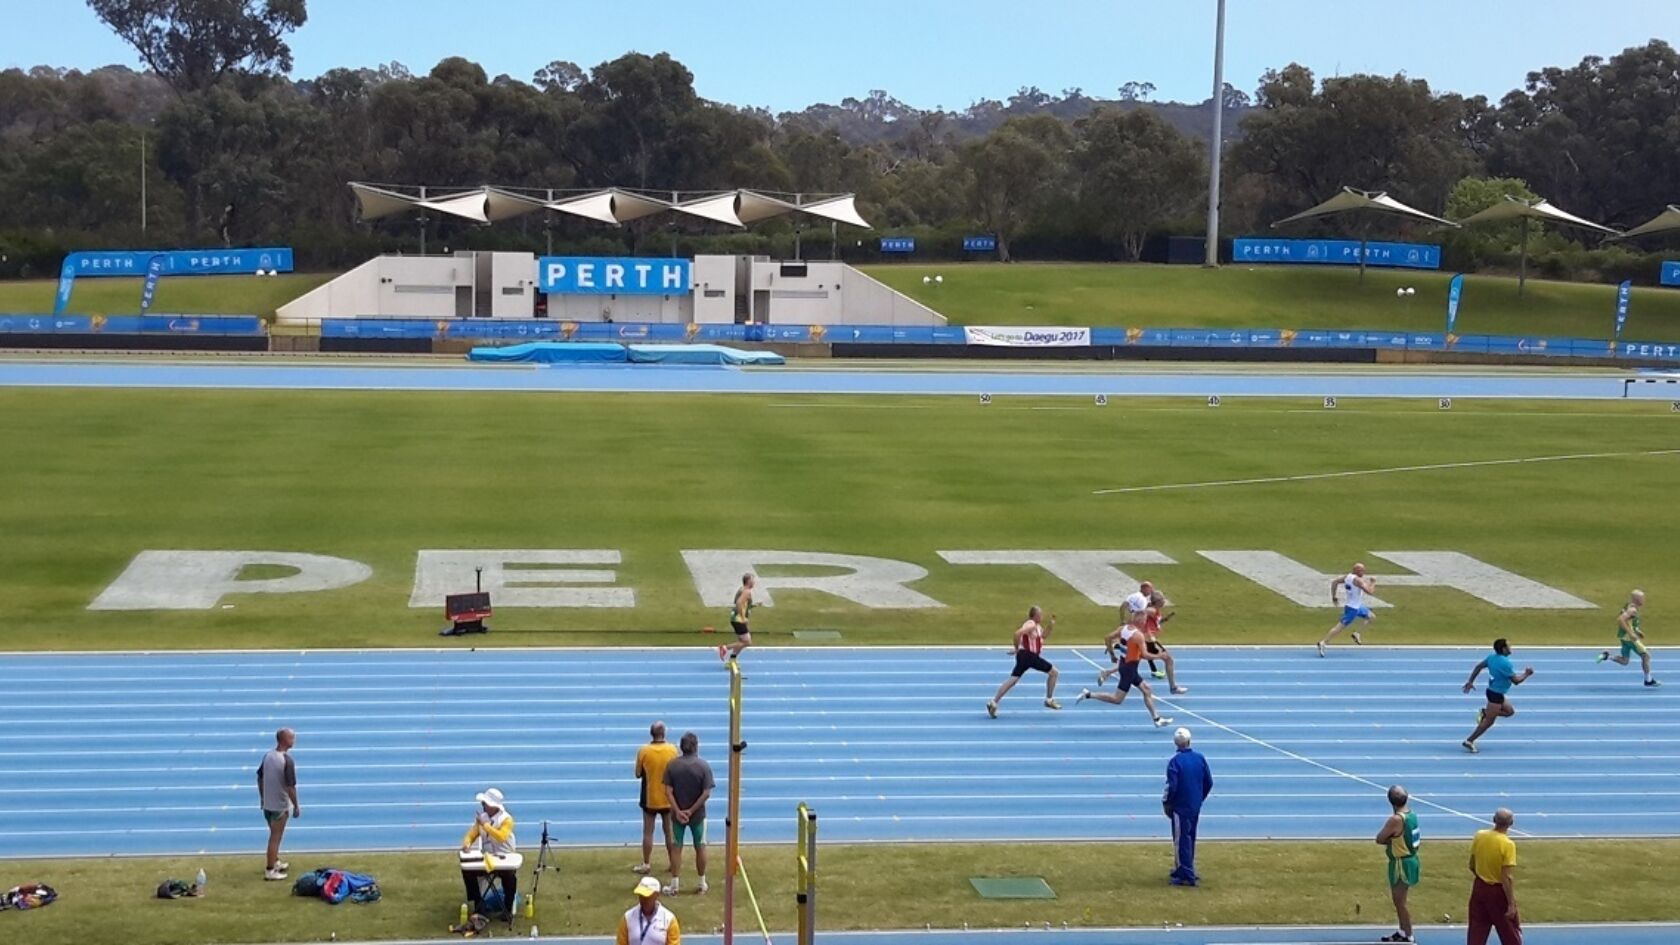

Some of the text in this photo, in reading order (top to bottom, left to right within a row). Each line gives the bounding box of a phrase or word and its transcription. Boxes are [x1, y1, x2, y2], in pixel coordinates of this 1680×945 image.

[881, 239, 915, 249] PERTH
[963, 238, 995, 248] PERTH
[1243, 246, 1291, 256] PERTH
[1343, 247, 1390, 258] PERTH
[81, 259, 133, 268] PERTH
[190, 256, 241, 267] PERTH
[547, 263, 681, 288] PERTH
[142, 262, 161, 308] PERTH
[1024, 331, 1058, 343] Daegu
[1059, 331, 1086, 341] 2017
[980, 393, 991, 402] 50
[1325, 397, 1335, 407] 35
[1440, 398, 1450, 408] 30
[87, 549, 1600, 611] PERTH
